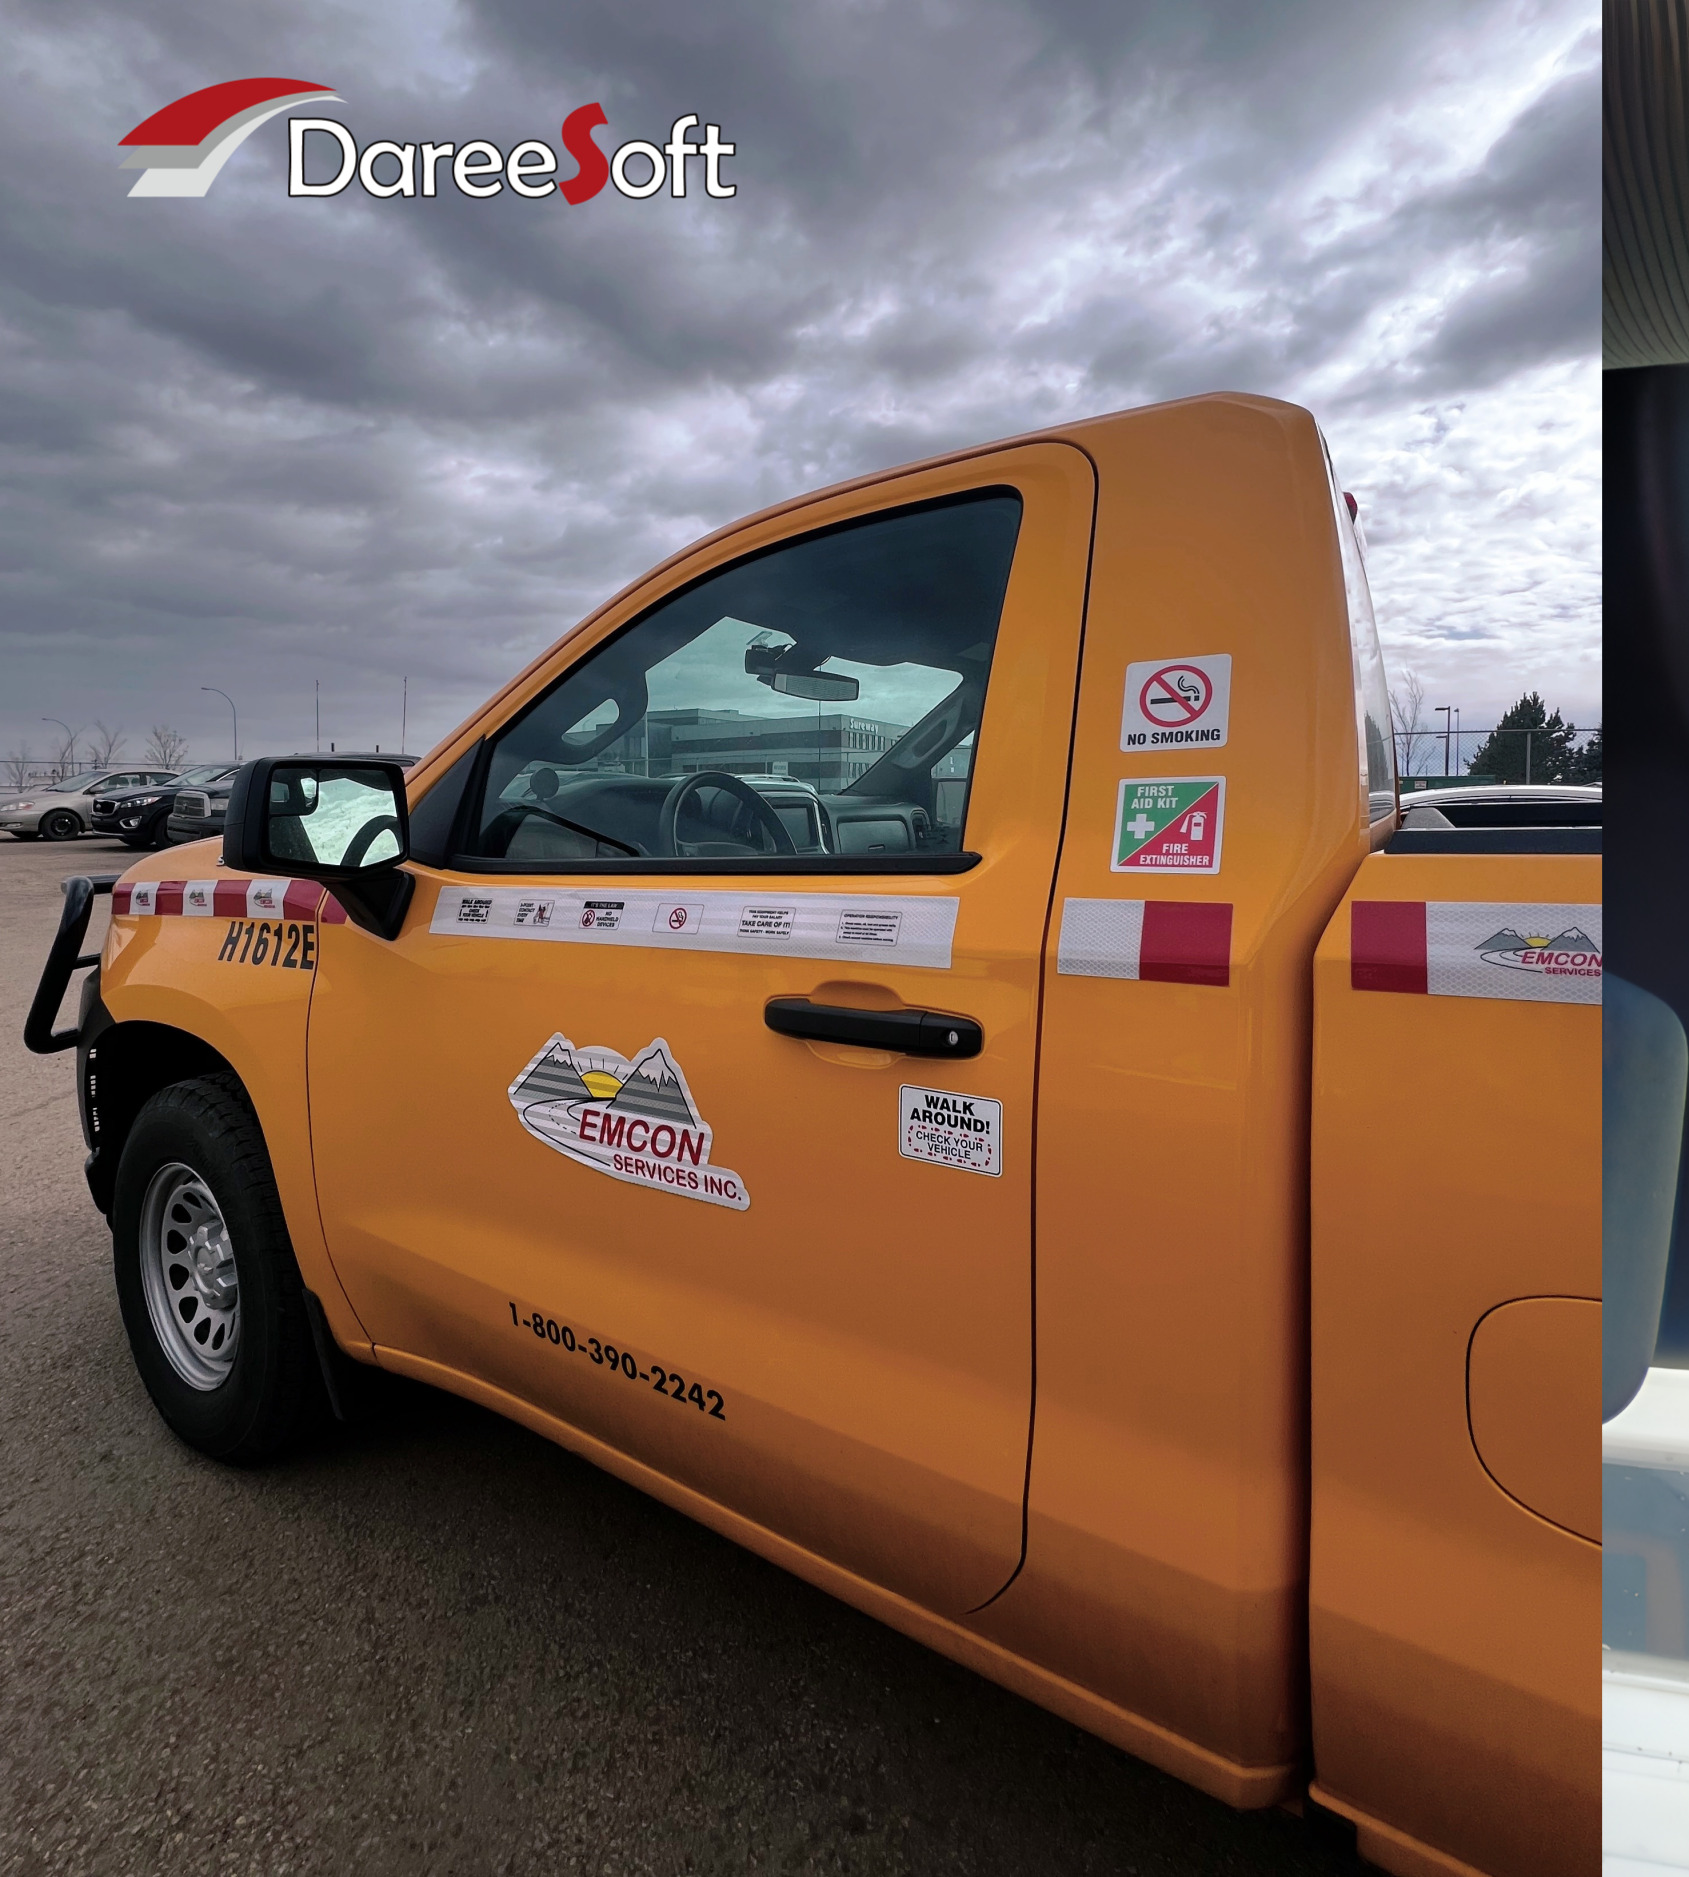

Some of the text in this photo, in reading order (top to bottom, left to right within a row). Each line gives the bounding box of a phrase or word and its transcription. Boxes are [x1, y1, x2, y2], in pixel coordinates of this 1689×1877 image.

[1127, 728, 1221, 746] NO SMOKING
[1137, 785, 1175, 797] FIRST
[1131, 797, 1178, 809] AID KIT
[1162, 843, 1188, 854] FIRE
[1139, 854, 1210, 866] EXTINGUISHER
[217, 921, 315, 970] H1612E
[1521, 950, 1602, 967] EMCON
[1545, 967, 1602, 977] SERVICES
[924, 1094, 975, 1117] WALK
[910, 1107, 990, 1135] AROUND!
[579, 1108, 704, 1166] EMCON
[915, 1130, 983, 1152] CHECK YOUR
[927, 1142, 971, 1160] VEHICLE
[613, 1153, 742, 1201] SERVICES INC.
[508, 1300, 726, 1421] 1-800-390-2242
